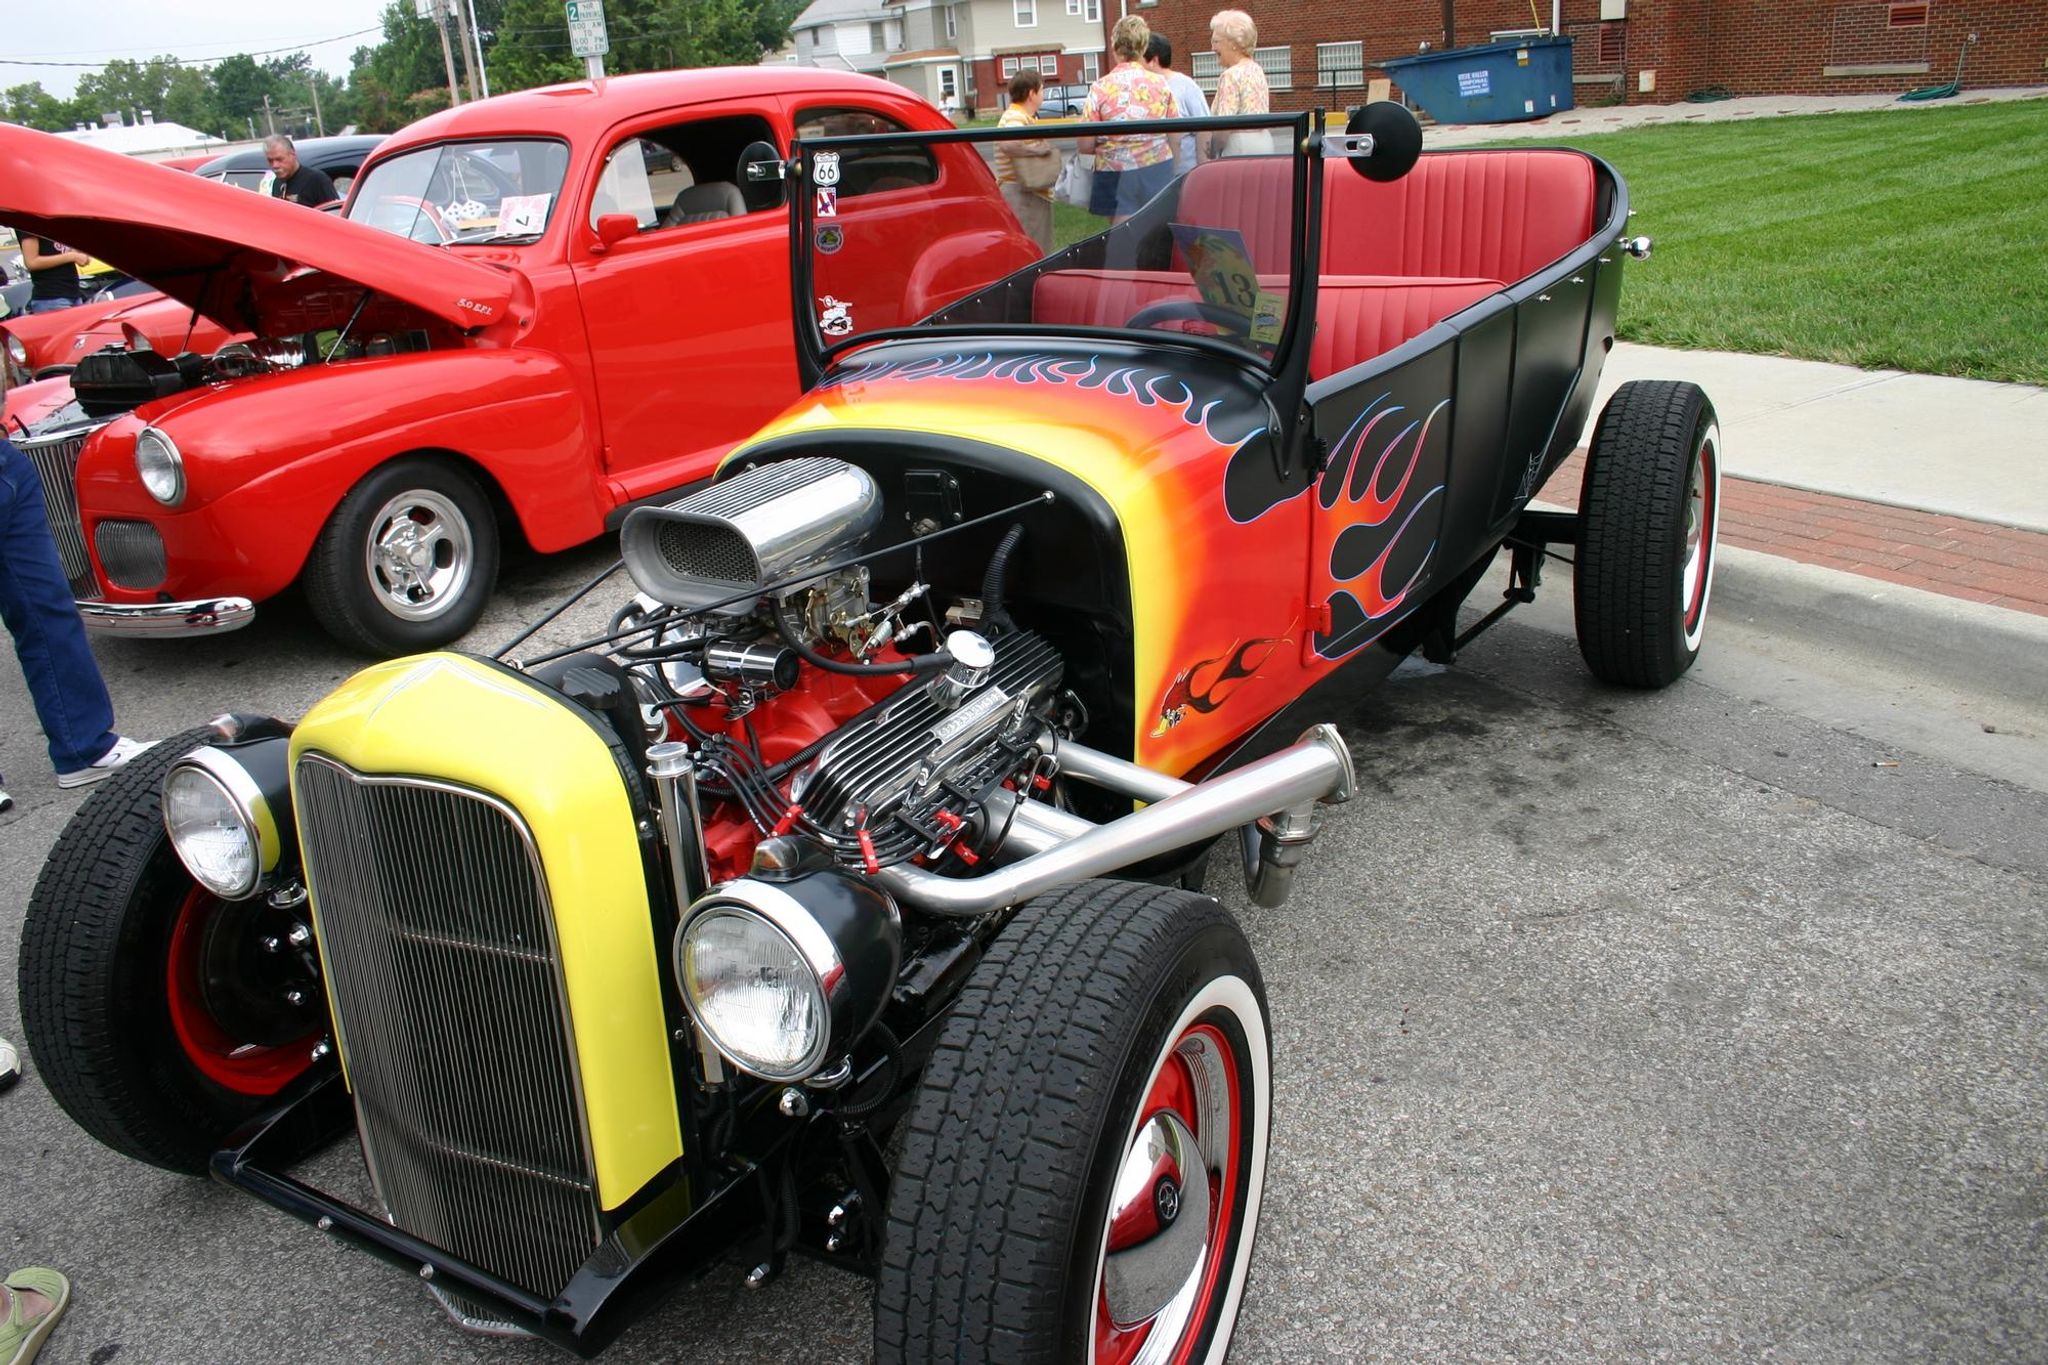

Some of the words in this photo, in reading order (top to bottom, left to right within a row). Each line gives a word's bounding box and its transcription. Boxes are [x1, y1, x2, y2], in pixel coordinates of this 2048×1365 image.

[570, 6, 578, 20] 2
[819, 163, 835, 180] 66
[1211, 271, 1256, 308] 13
